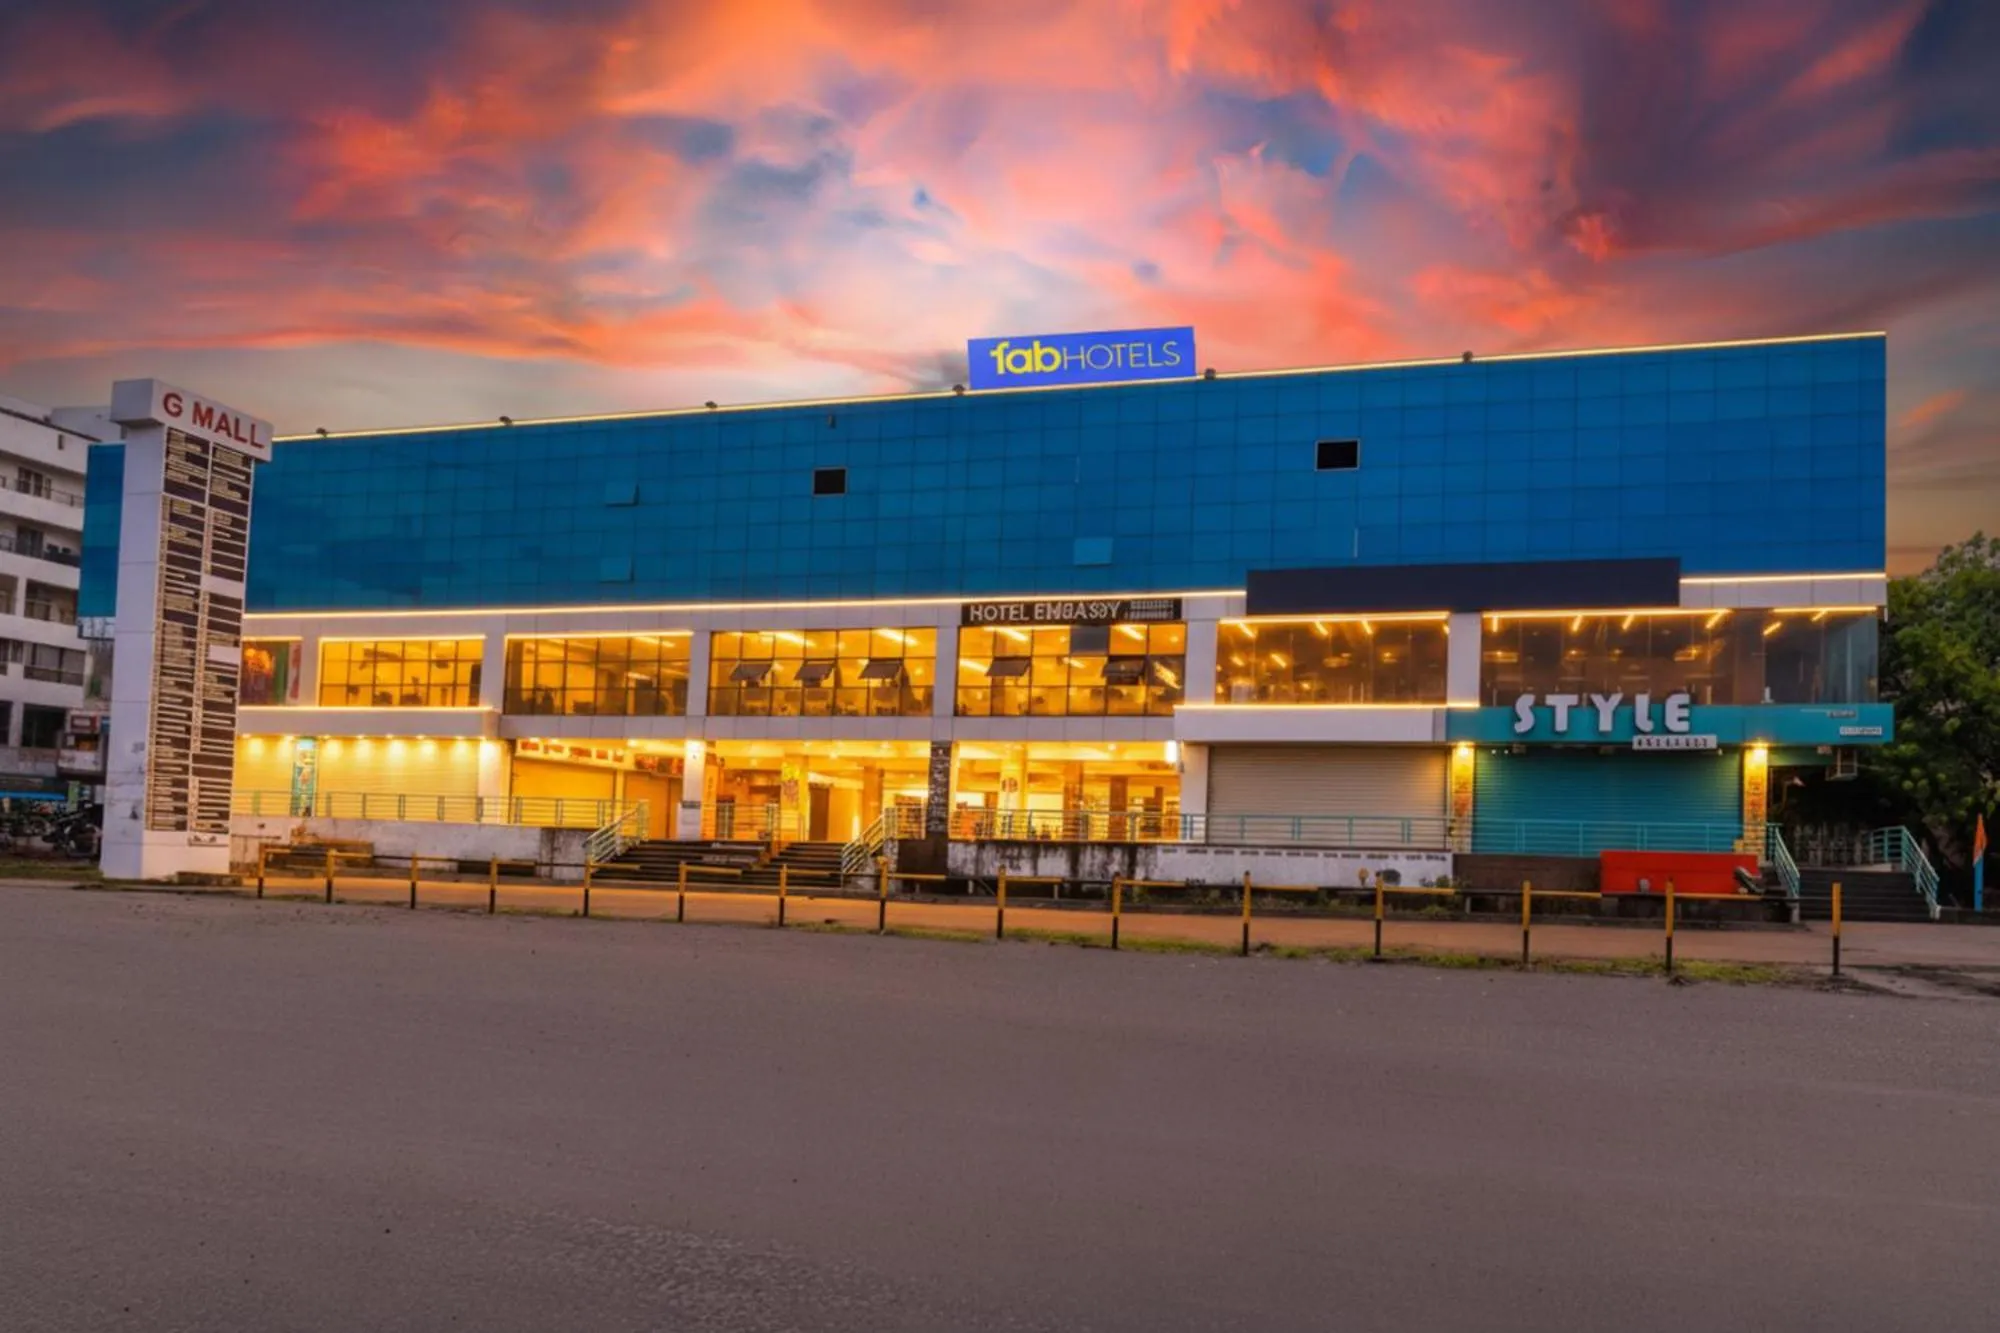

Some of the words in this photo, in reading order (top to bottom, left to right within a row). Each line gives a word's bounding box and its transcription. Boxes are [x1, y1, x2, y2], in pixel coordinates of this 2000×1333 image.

[989, 340, 1181, 375] fabHOTELS
[163, 392, 184, 418] G
[191, 401, 265, 448] MALL
[970, 603, 1030, 621] HOTEL
[1514, 693, 1691, 733] STYLE
